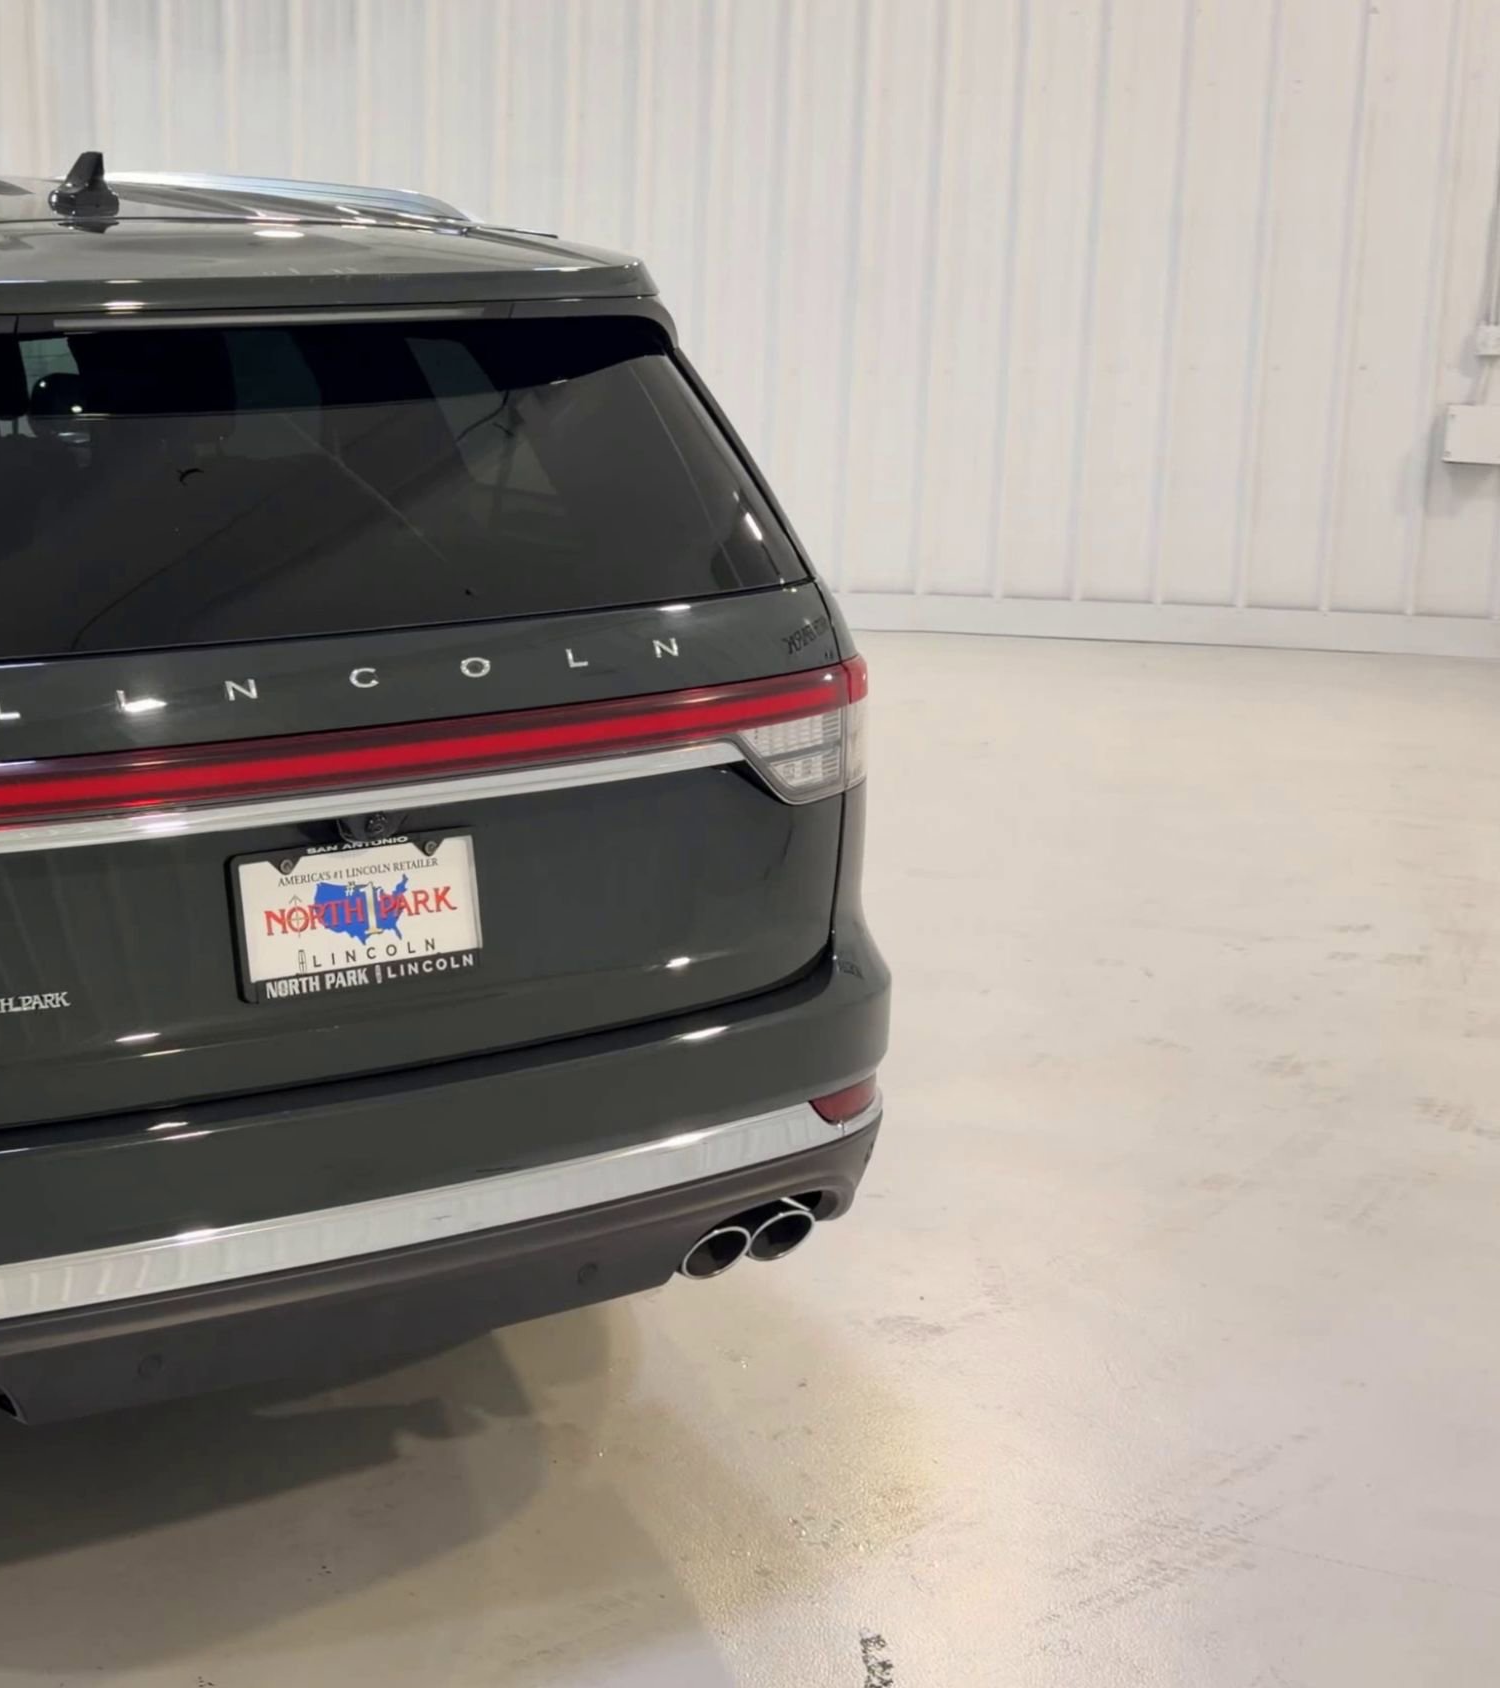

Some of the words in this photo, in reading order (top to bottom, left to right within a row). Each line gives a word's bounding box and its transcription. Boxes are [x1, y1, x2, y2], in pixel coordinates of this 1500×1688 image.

[306, 844, 338, 855] SAN
[342, 835, 409, 850] ANTONIO
[277, 871, 331, 887] AMERICA'S
[333, 868, 344, 880] #1
[346, 864, 391, 879] LINCOLN
[393, 857, 438, 873] RETAILER
[264, 897, 366, 936] NORTH
[378, 886, 458, 920] PARK
[312, 938, 436, 968] LINCOLN
[266, 974, 321, 999] NORTH
[325, 967, 370, 991] PARK
[387, 953, 475, 979] LINCOLN
[18, 991, 71, 1012] PARK
